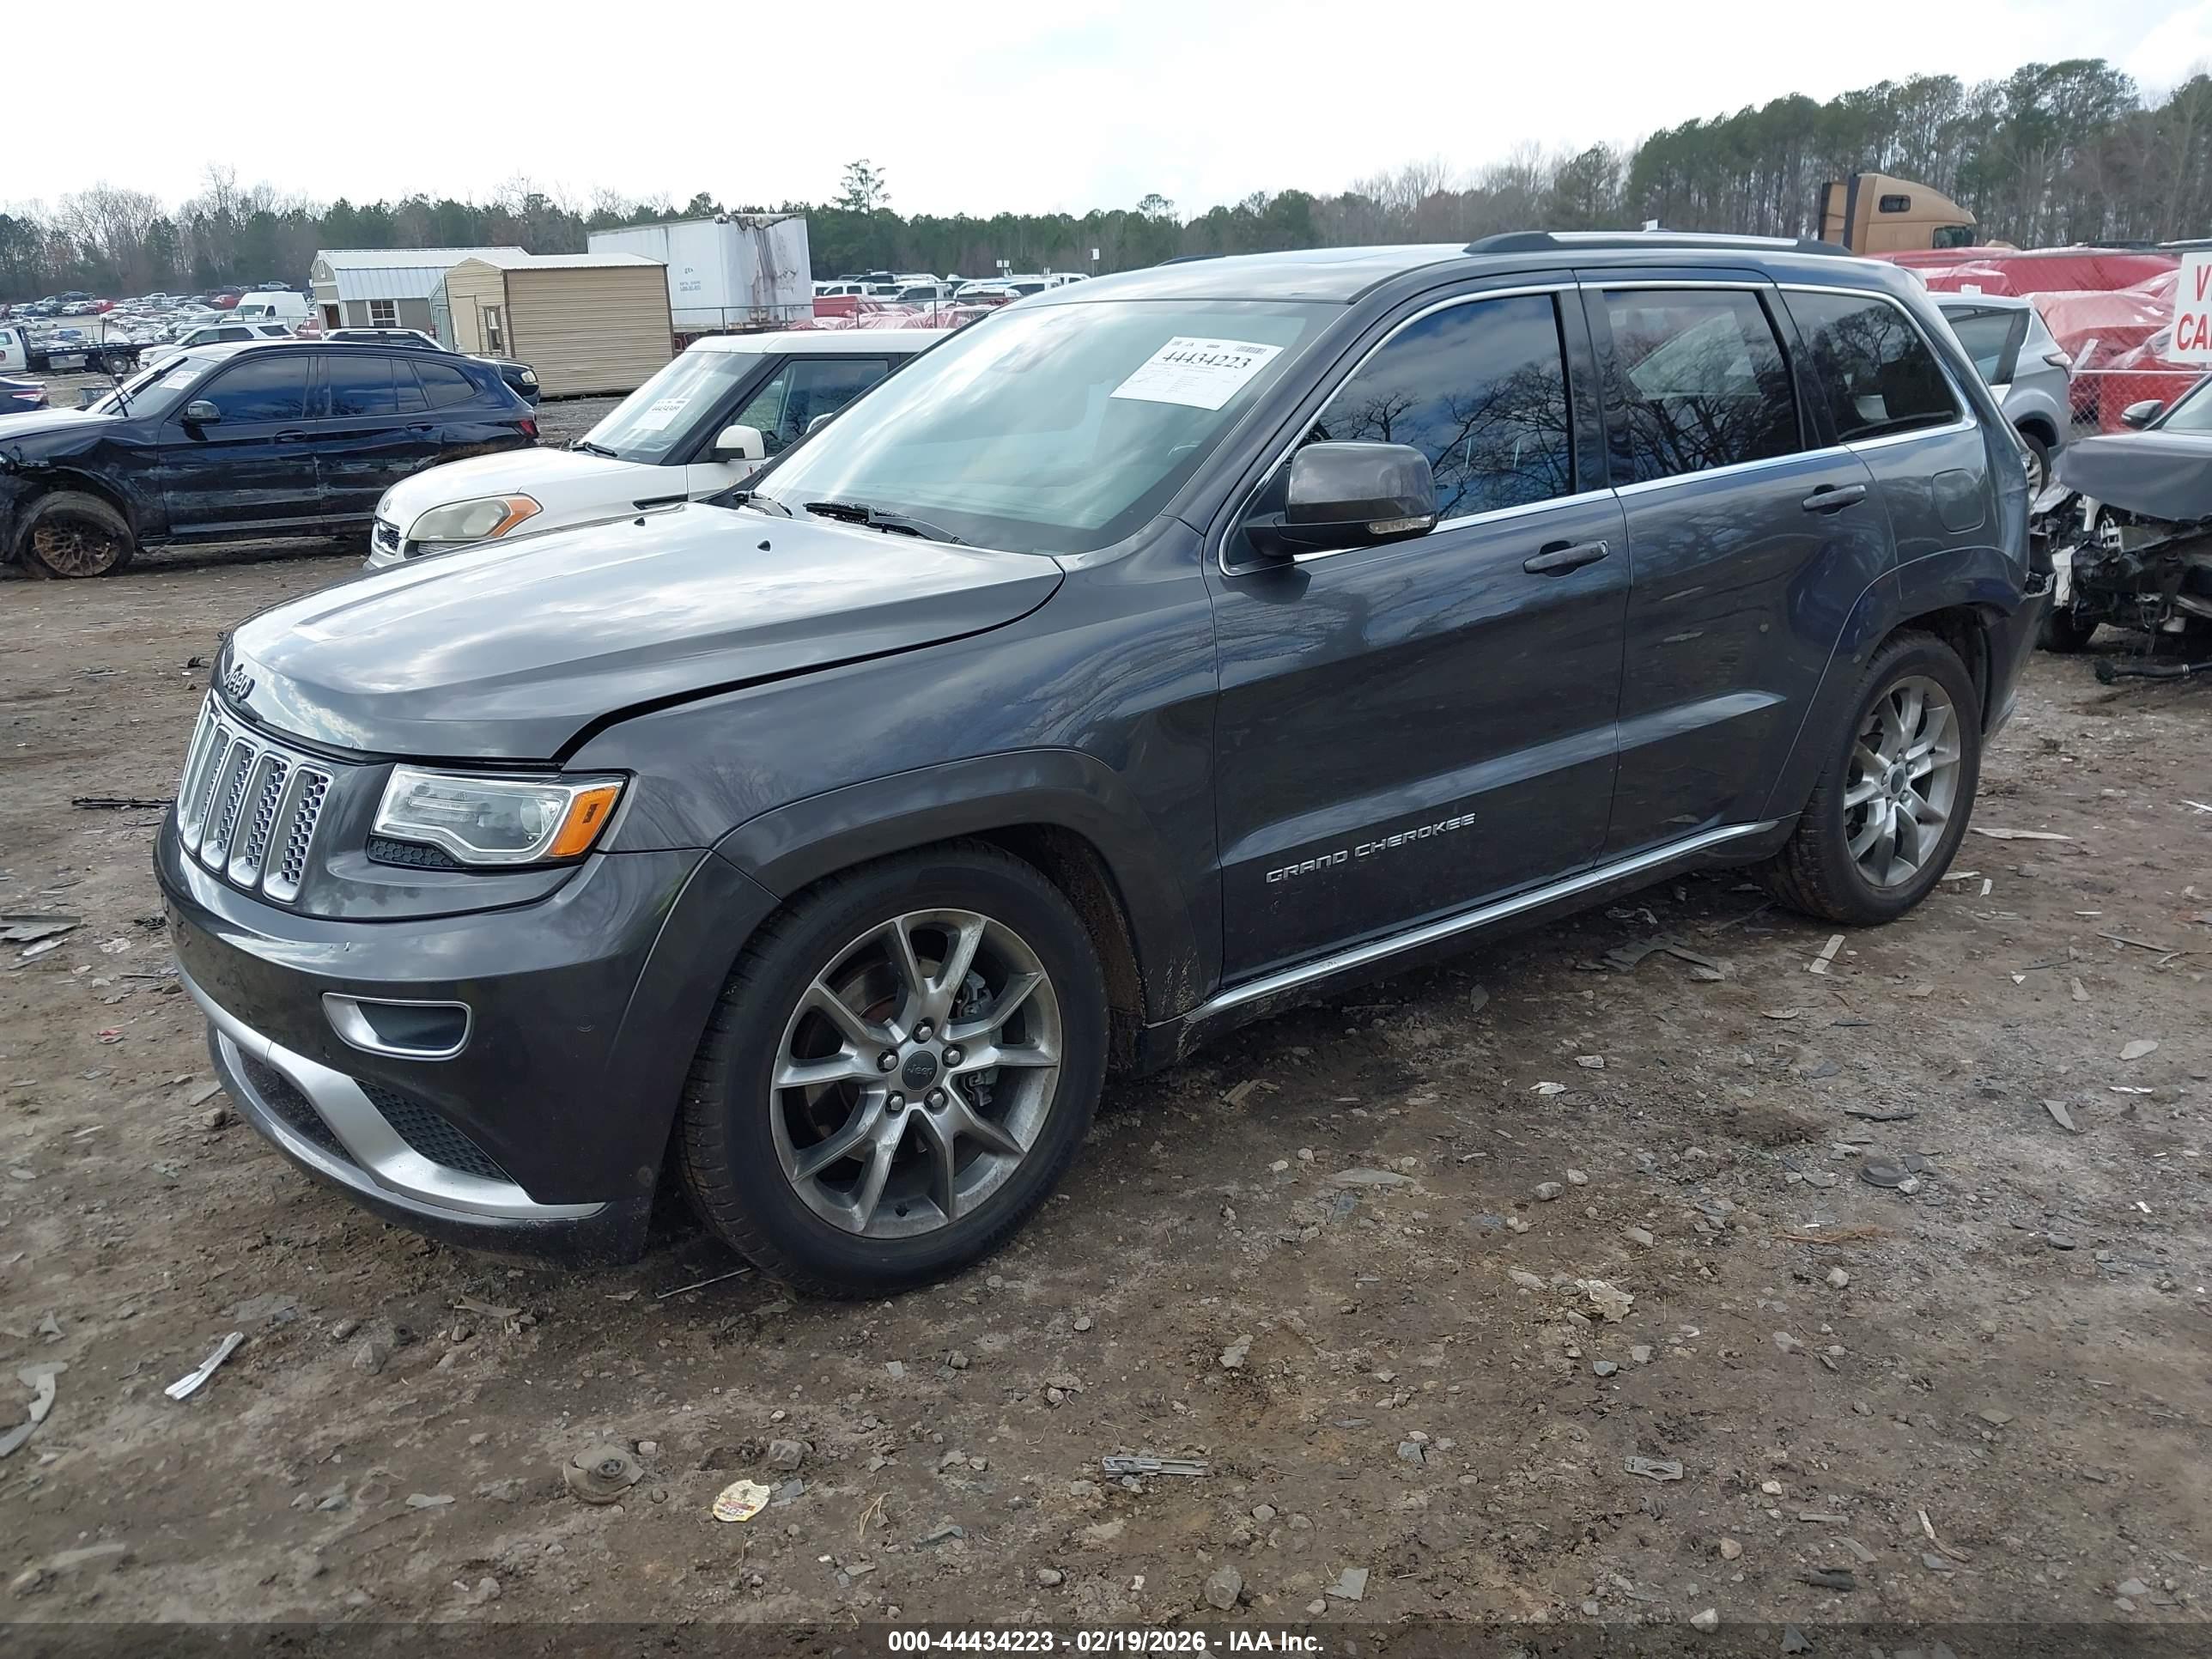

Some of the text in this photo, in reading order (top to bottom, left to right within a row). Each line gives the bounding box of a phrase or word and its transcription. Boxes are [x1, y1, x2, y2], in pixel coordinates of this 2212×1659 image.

[2197, 264, 2212, 301] V
[2178, 313, 2212, 350] CA
[1162, 350, 1252, 369] 44434223
[224, 663, 255, 702] Jeep
[1266, 813, 1476, 884] GRAND CHEROKEE
